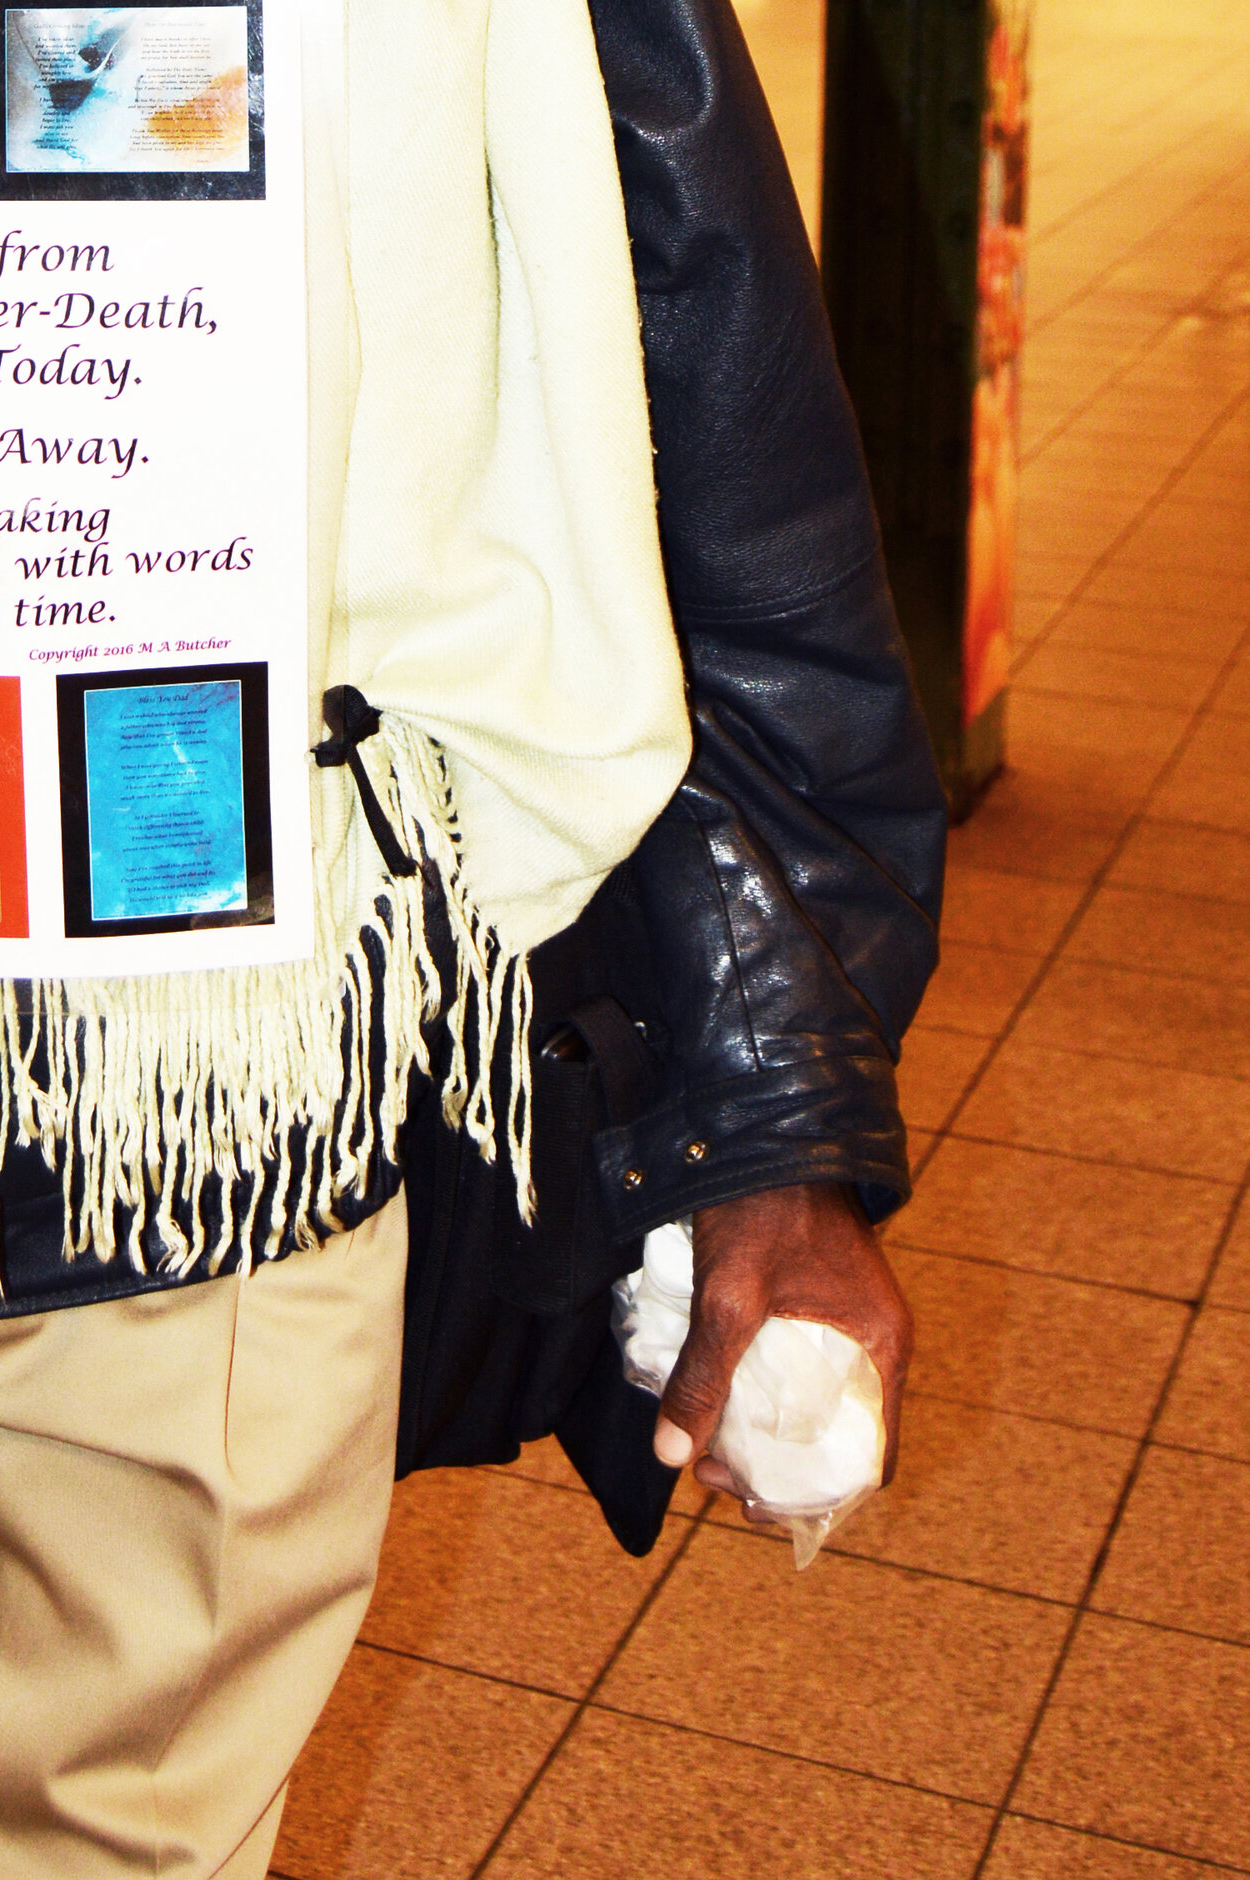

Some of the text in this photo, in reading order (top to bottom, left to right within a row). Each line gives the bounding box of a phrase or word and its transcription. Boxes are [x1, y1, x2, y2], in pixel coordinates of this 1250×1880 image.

[14, 541, 113, 581] with
[126, 536, 254, 574] words
[14, 595, 117, 625] time.
[28, 637, 233, 663] Copyright 2016 M A Butcher
